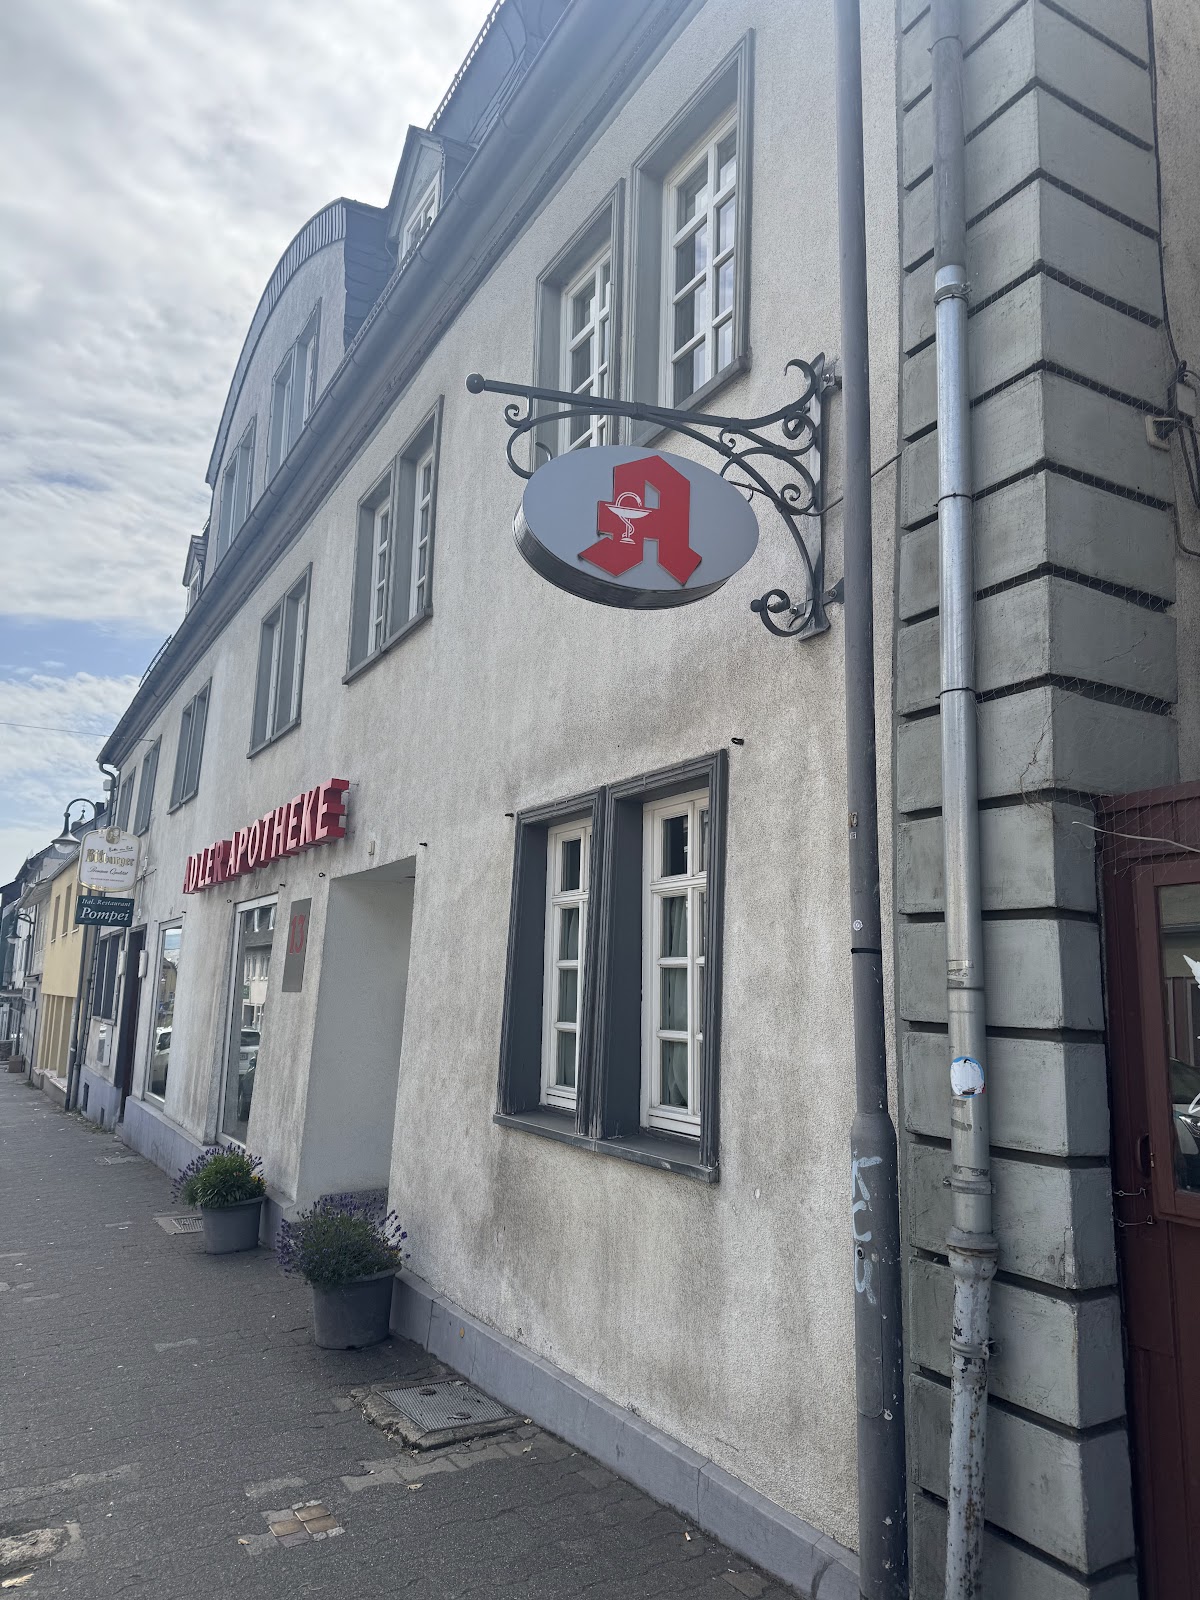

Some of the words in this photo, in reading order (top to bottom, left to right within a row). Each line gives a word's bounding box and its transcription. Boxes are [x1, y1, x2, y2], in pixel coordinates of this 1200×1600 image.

[183, 839, 233, 894] ADLER
[226, 778, 349, 878] APOTHEKE
[85, 848, 135, 867] Bitburger
[97, 899, 131, 907] Restaurant
[80, 906, 130, 923] Pompei
[289, 913, 305, 954] 13
